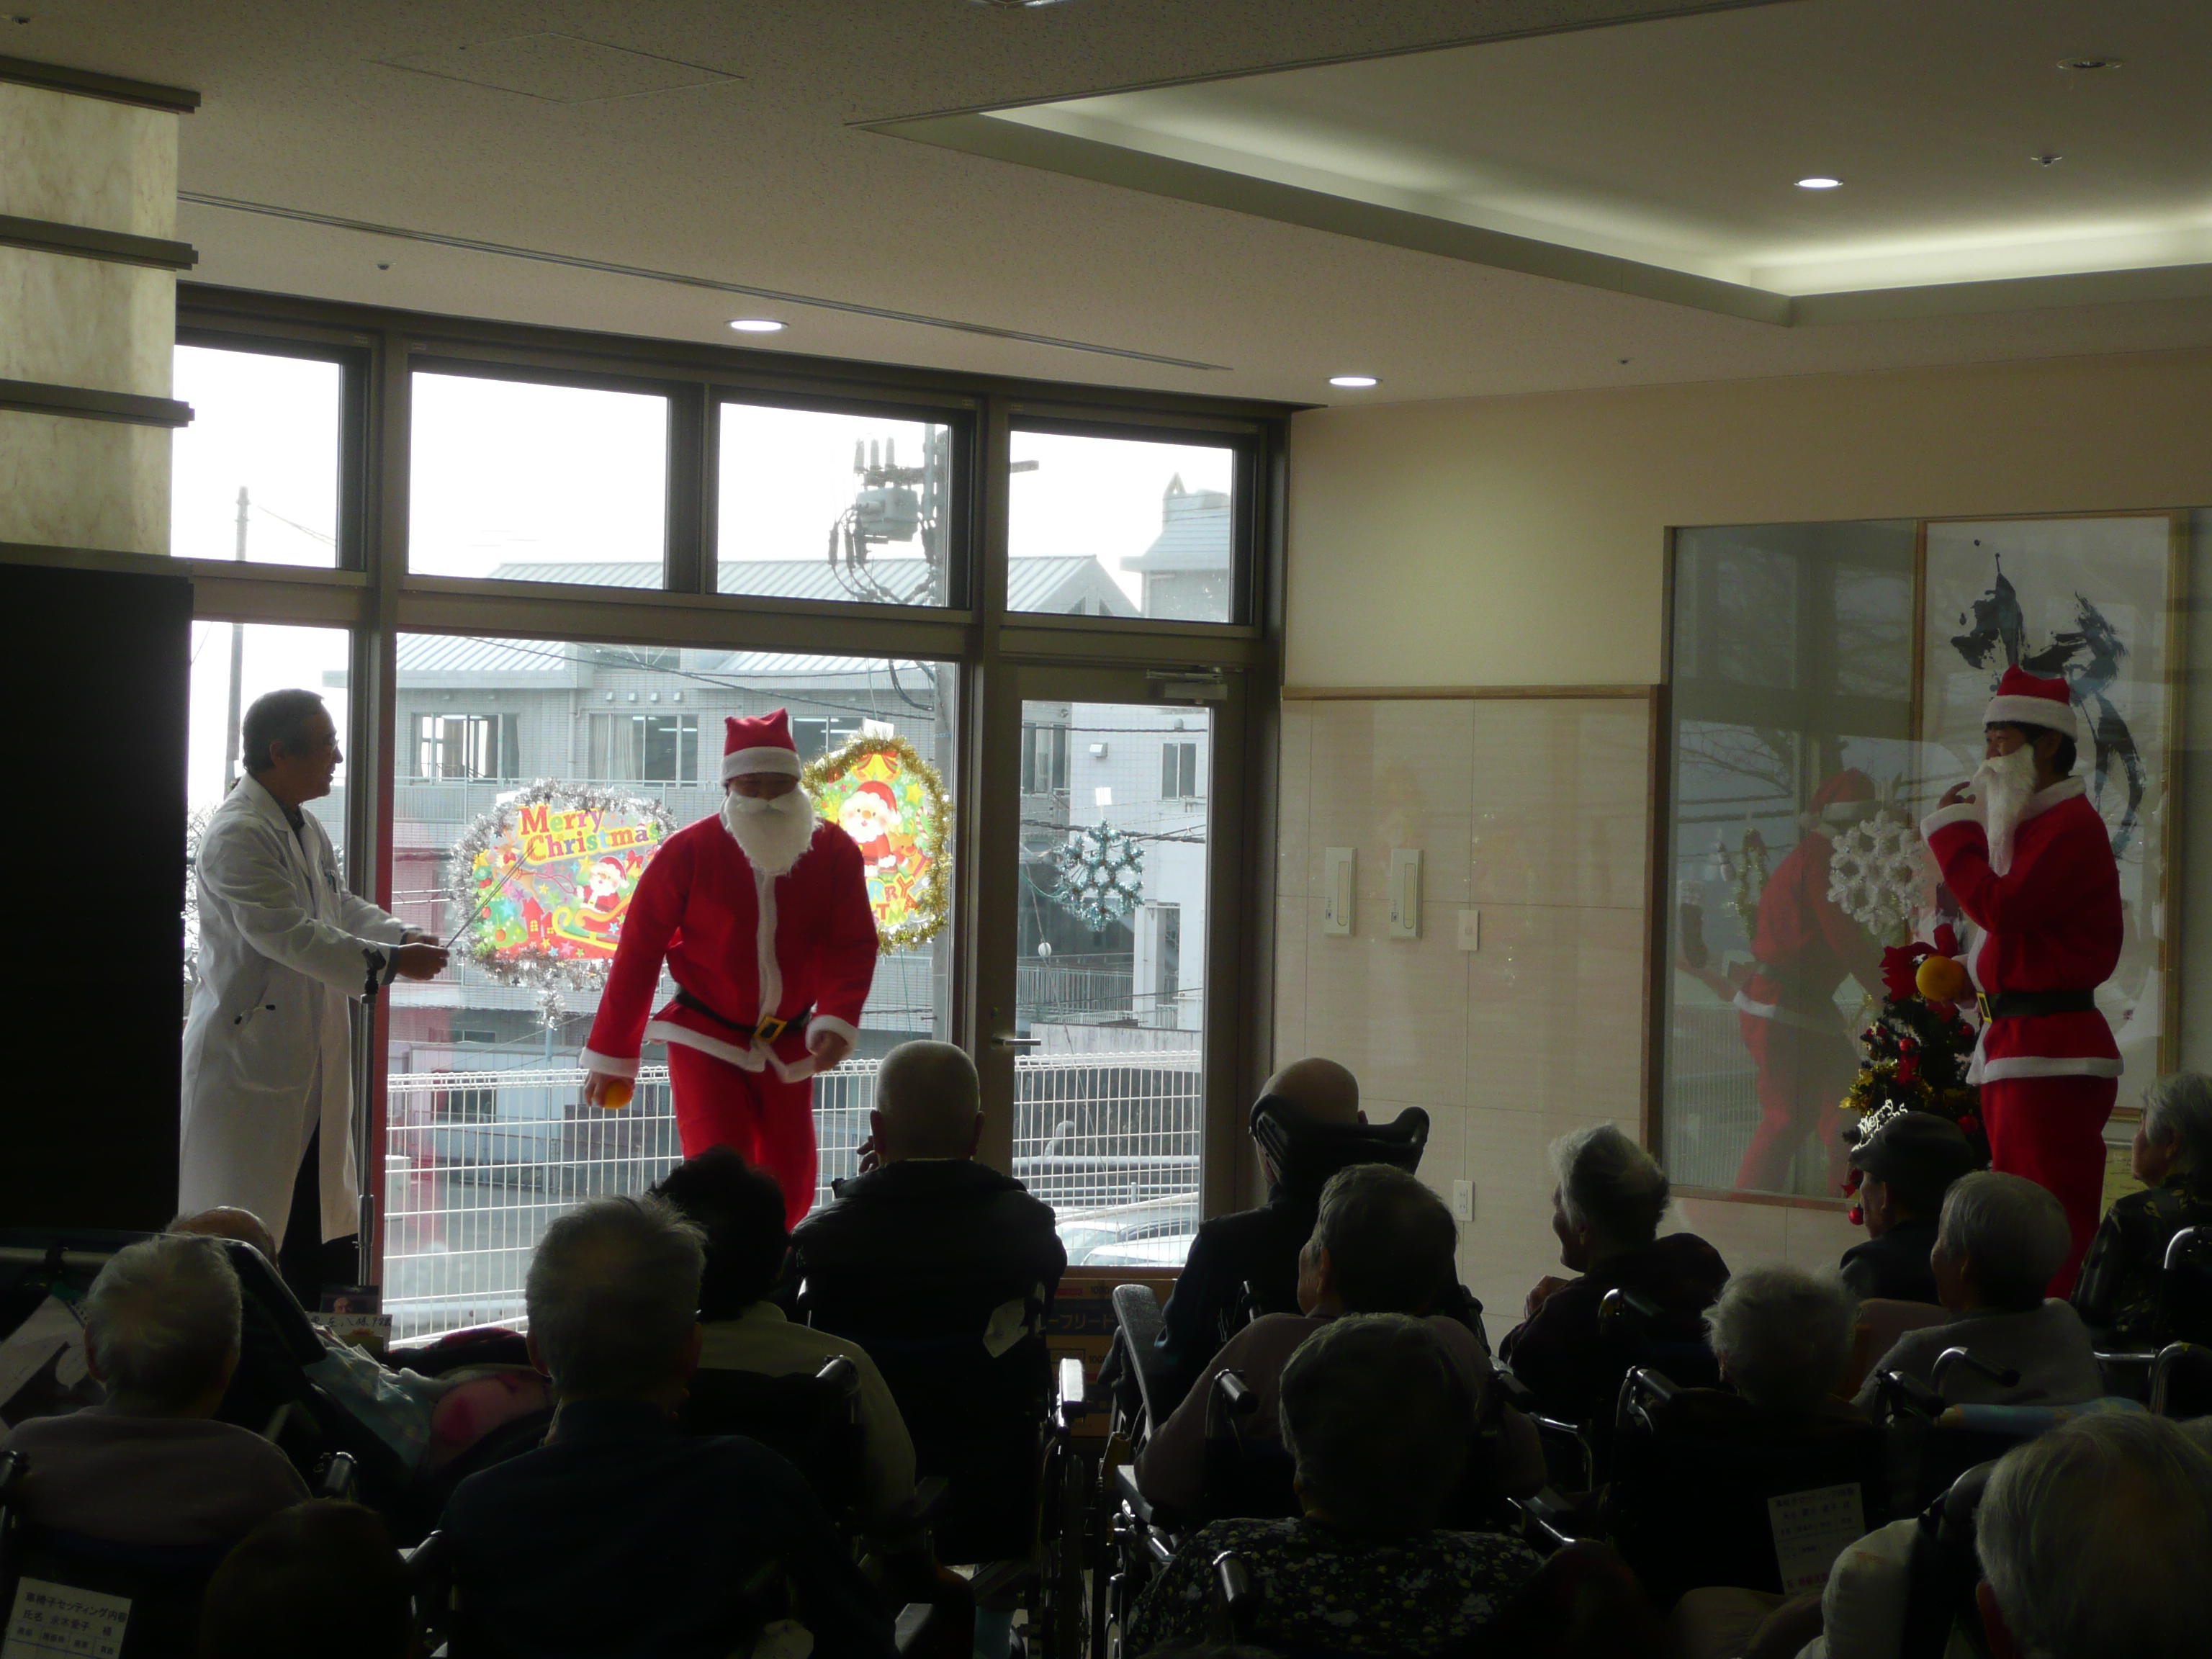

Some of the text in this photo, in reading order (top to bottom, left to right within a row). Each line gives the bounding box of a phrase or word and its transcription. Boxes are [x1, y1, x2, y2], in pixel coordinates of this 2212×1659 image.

[520, 805, 603, 836] Merry
[526, 822, 660, 862] Christmas
[868, 875, 914, 902] RRY
[1048, 1312, 1115, 1331] ーフリード
